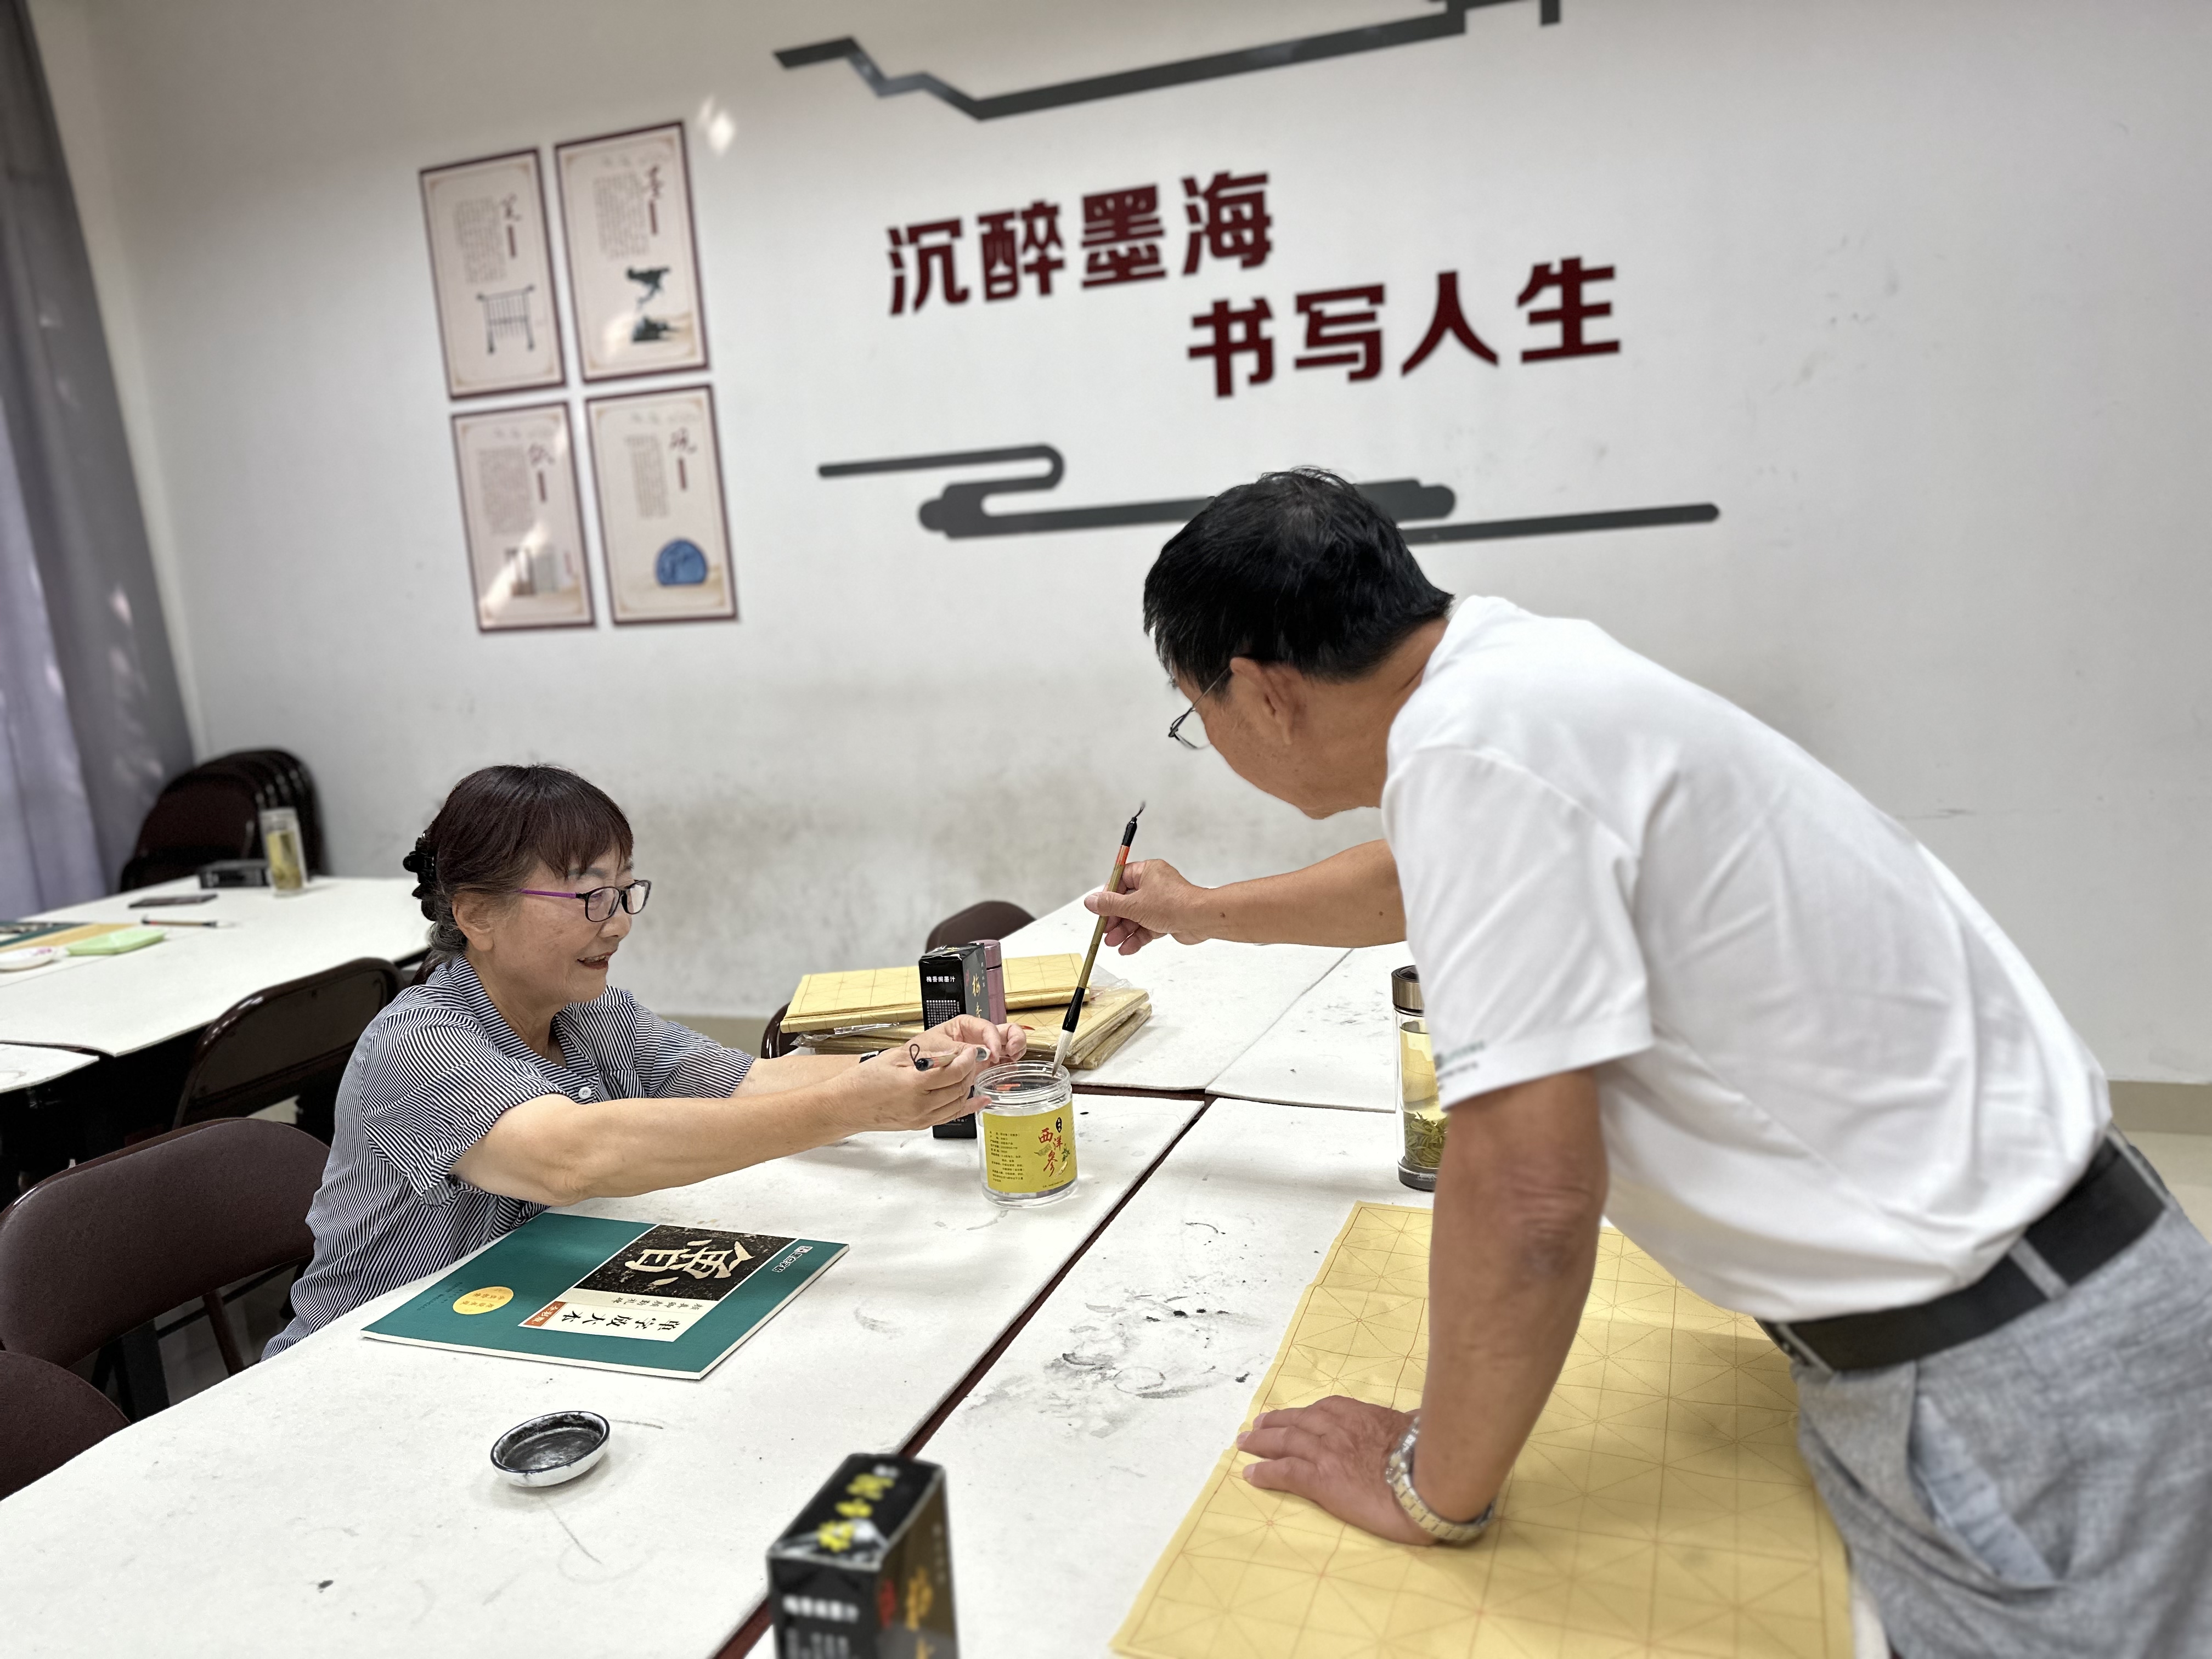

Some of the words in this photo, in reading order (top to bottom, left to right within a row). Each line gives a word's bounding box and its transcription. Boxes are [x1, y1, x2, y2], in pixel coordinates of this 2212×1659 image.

[887, 171, 1273, 316] 沉醉墨海
[1187, 256, 1622, 399] 书写人生
[561, 1310, 681, 1331] 单字放大本
